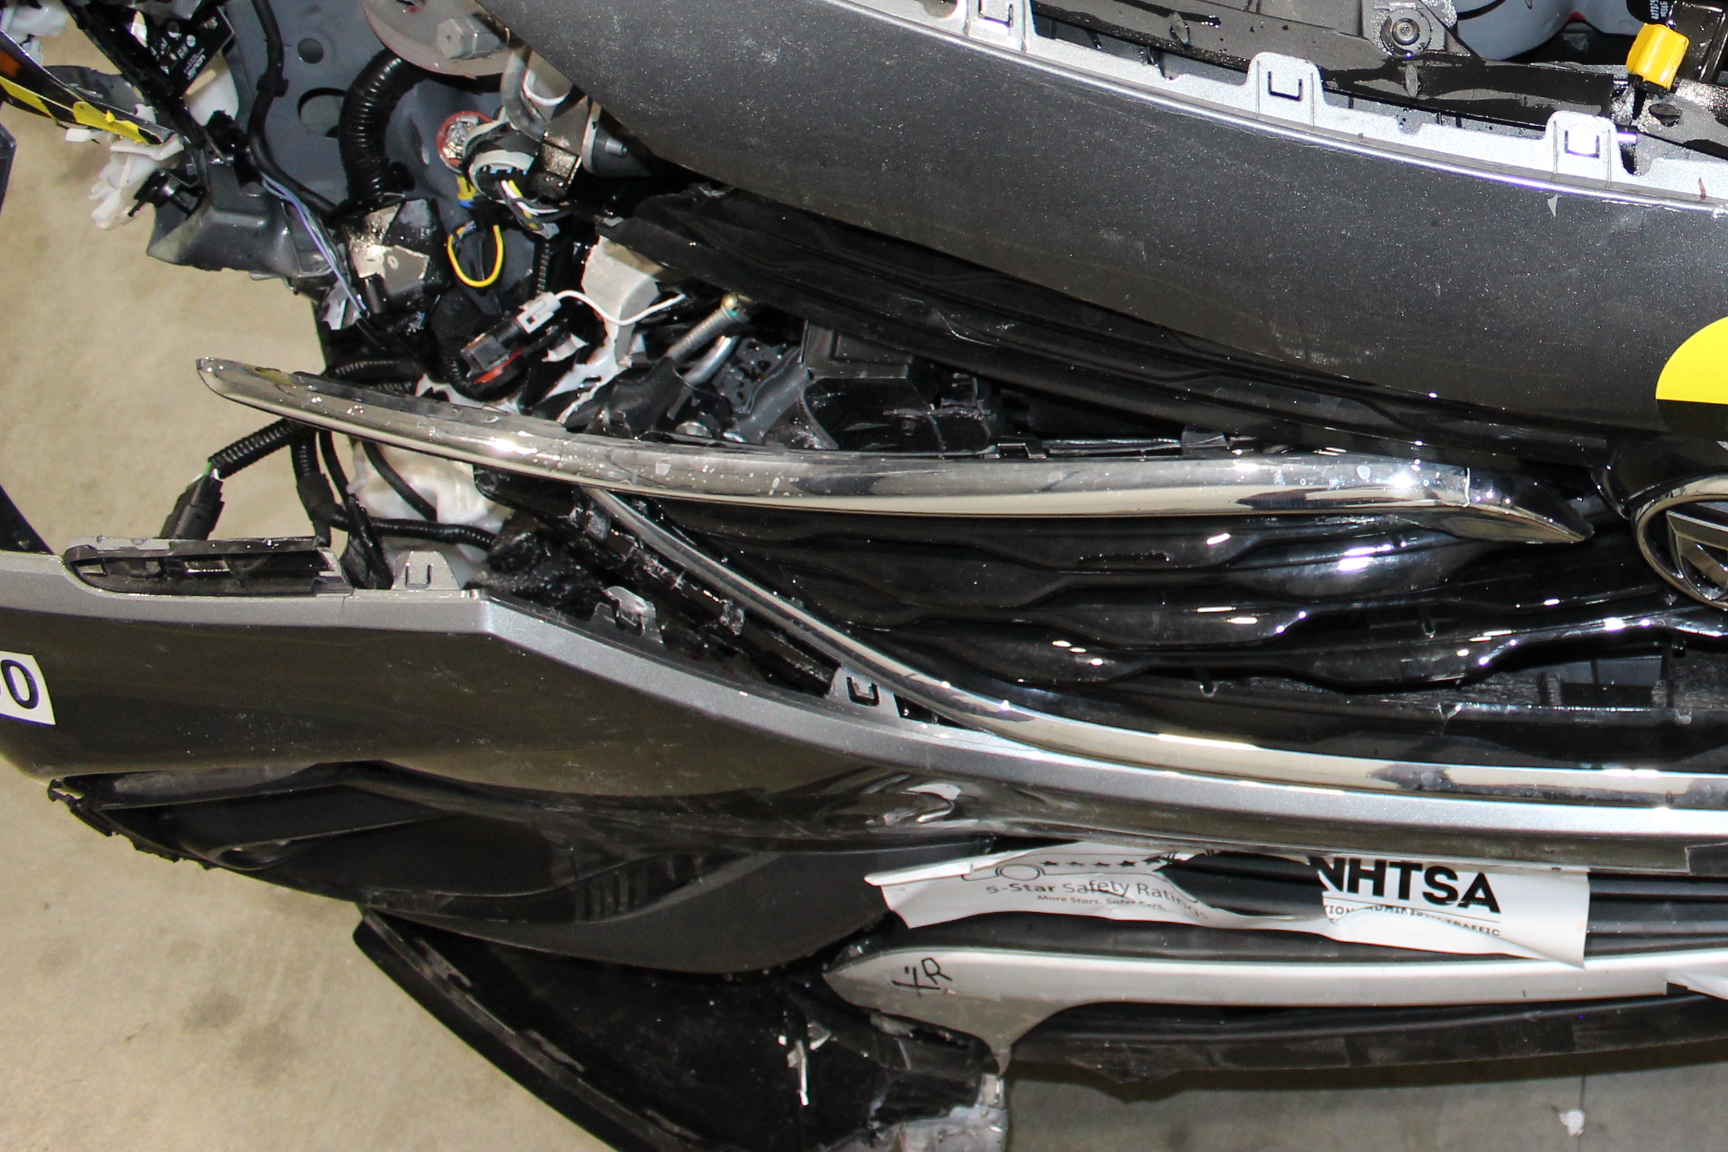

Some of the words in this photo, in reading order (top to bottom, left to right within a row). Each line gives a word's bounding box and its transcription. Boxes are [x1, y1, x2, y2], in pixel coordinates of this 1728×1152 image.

[986, 882, 1056, 896] 5-Star
[1063, 879, 1130, 898] Safety
[1306, 855, 1502, 915] NHTSA
